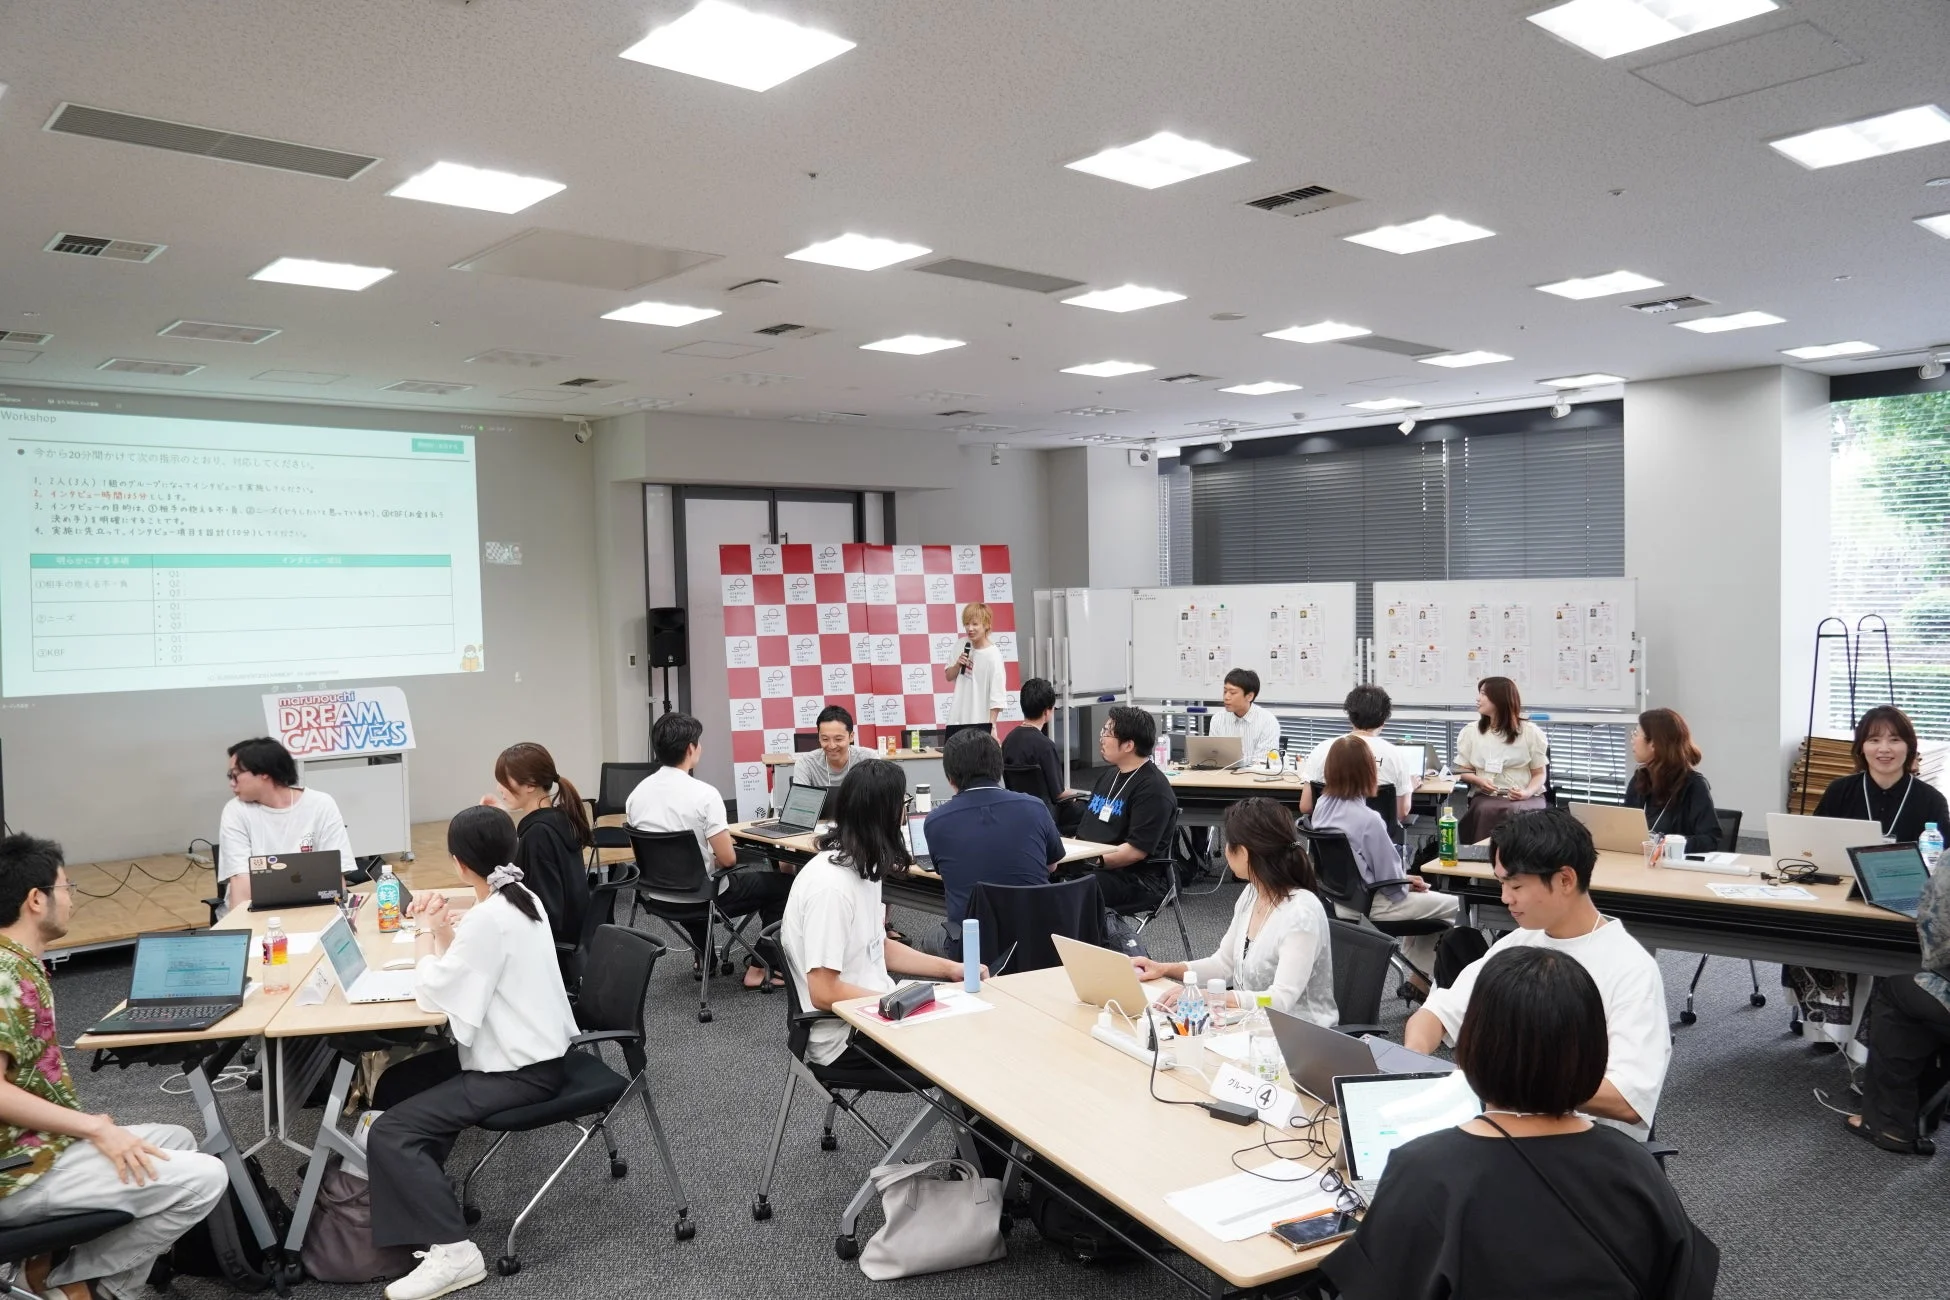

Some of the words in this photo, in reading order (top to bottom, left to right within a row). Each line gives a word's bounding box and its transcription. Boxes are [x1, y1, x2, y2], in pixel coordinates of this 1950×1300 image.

[1, 410, 57, 424] Workshop
[279, 691, 355, 706] marunouchi
[279, 701, 385, 732] DREAM
